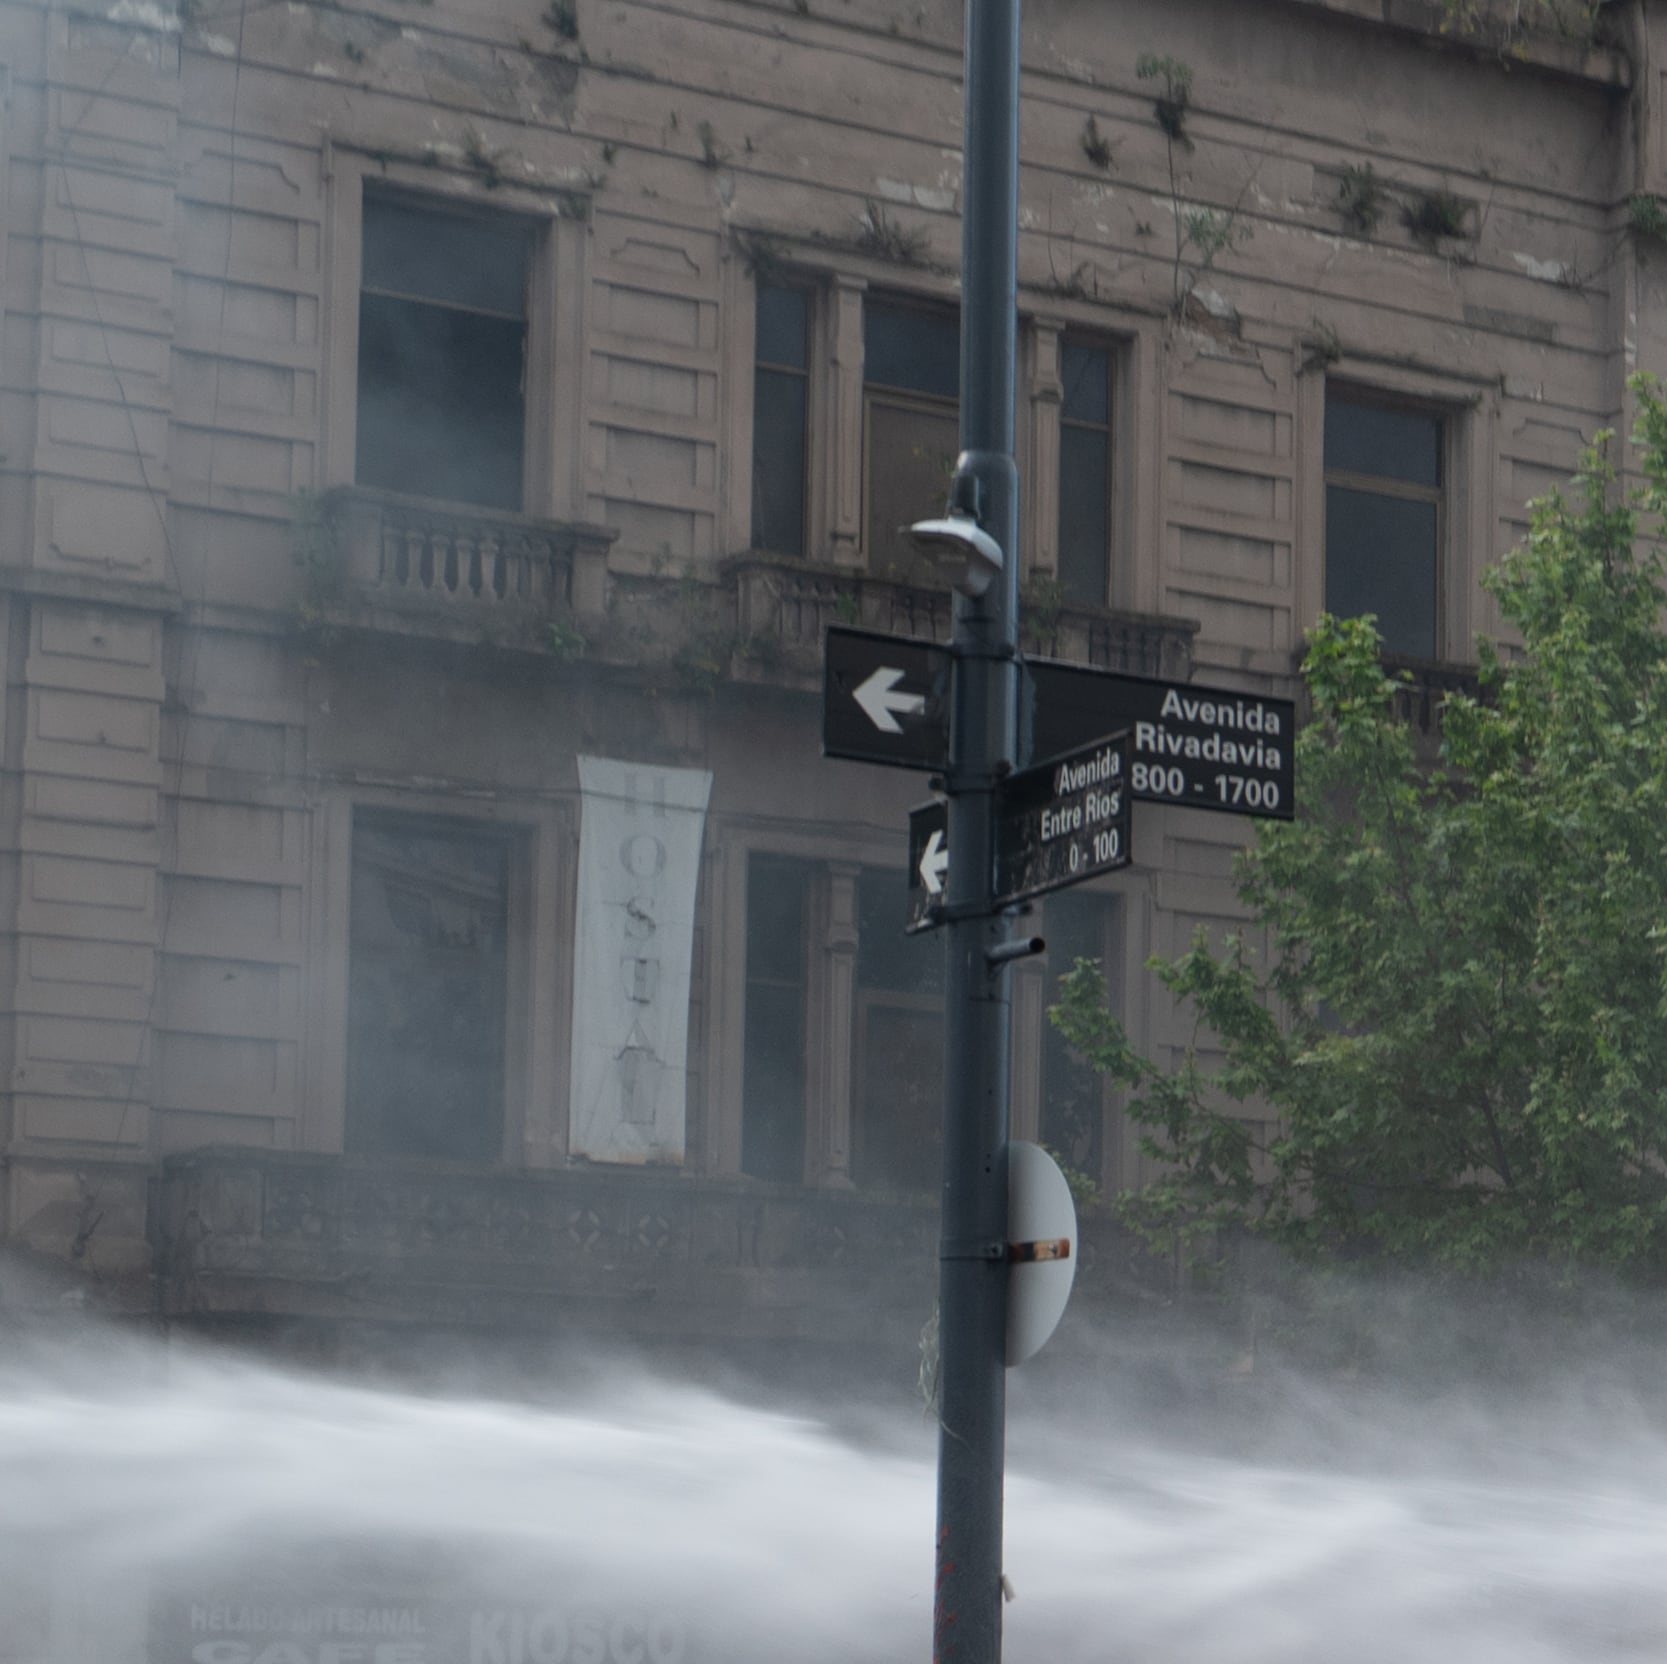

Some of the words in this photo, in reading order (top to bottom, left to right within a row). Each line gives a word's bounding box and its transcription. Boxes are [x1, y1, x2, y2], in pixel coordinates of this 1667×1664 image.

[1160, 689, 1281, 735] Avenida
[1135, 721, 1281, 770] Rivadavia
[1058, 746, 1121, 796] Avenida
[1132, 762, 1184, 796] 800
[1215, 775, 1280, 810] 1700
[1041, 805, 1082, 842] Entre
[1069, 842, 1079, 873] 0
[1093, 828, 1119, 864] 100
[612, 771, 668, 1126] HOSTAL
[290, 1606, 426, 1636] ARTESANAL
